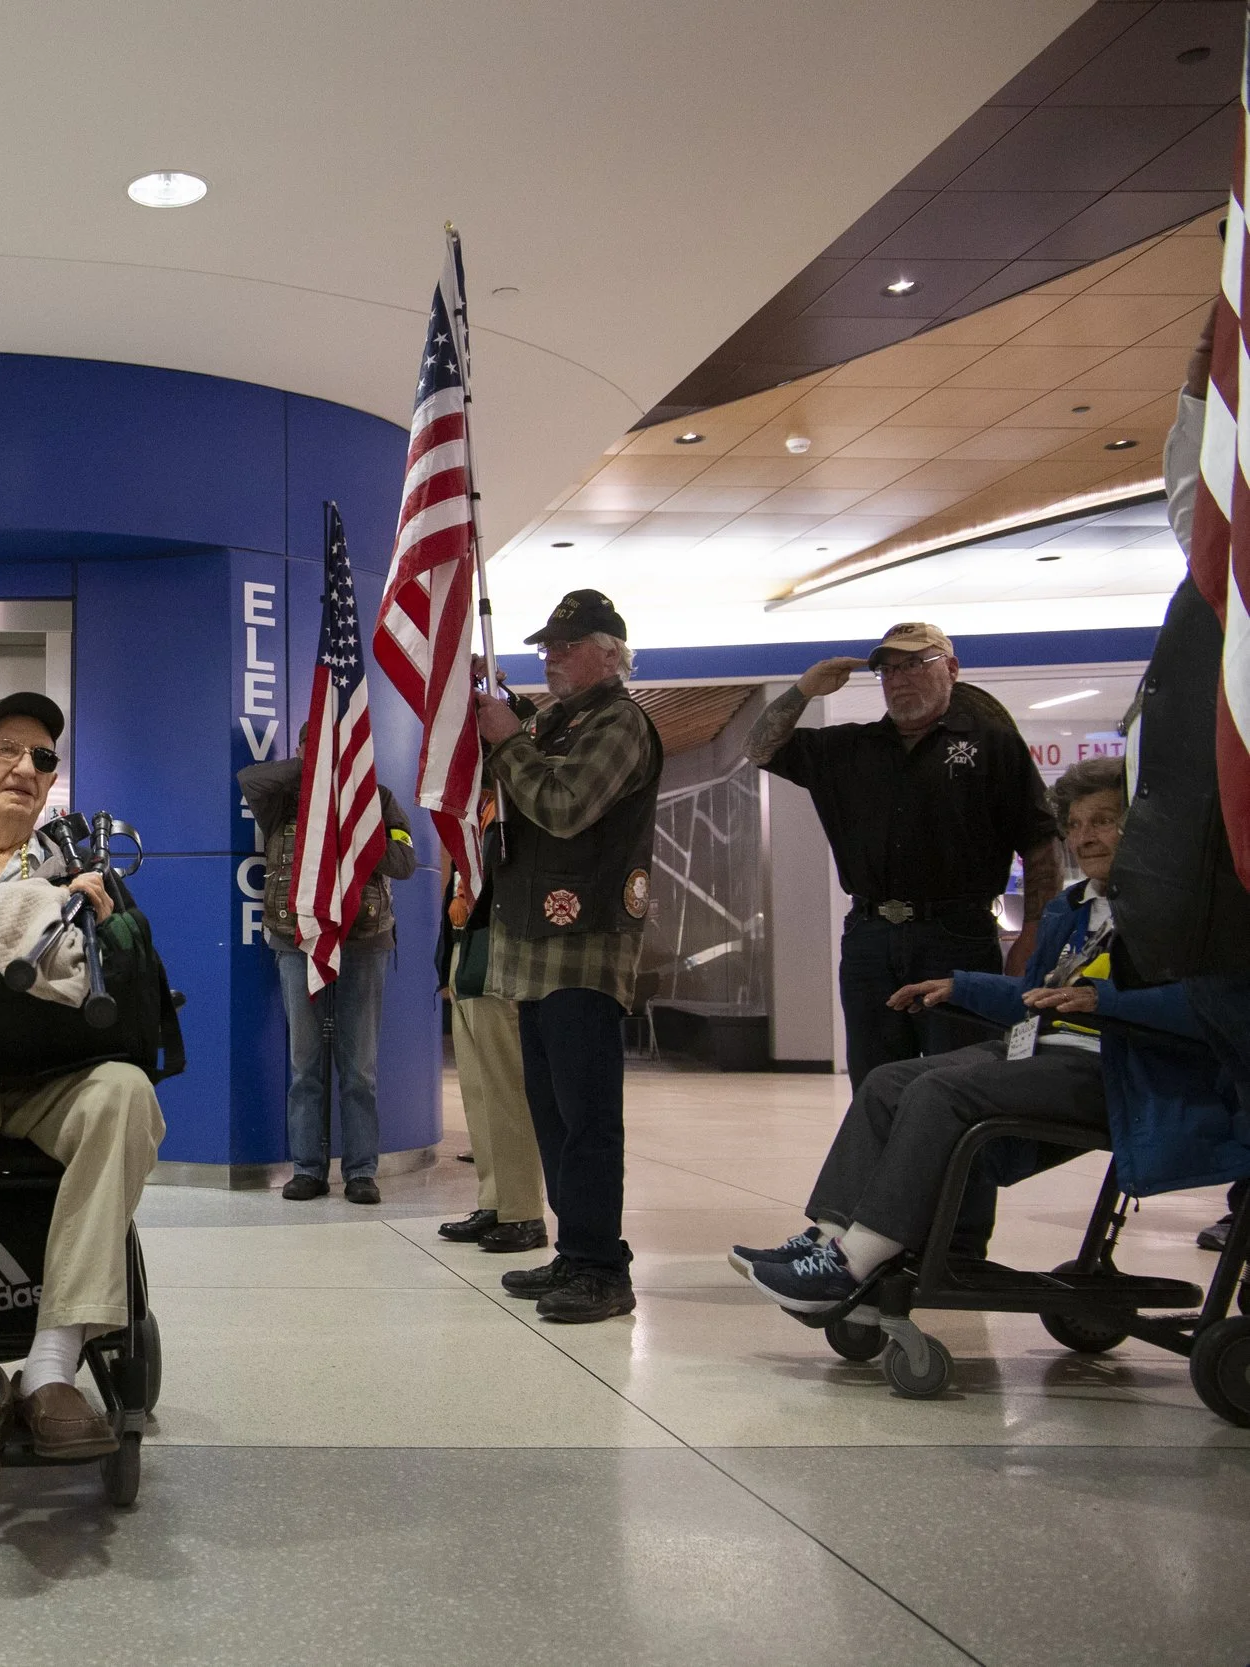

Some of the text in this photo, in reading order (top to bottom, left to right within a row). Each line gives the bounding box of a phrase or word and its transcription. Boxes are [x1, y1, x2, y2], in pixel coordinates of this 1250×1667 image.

[236, 581, 280, 945] ELEVTOR
[1029, 742, 1123, 766] NO ENT
